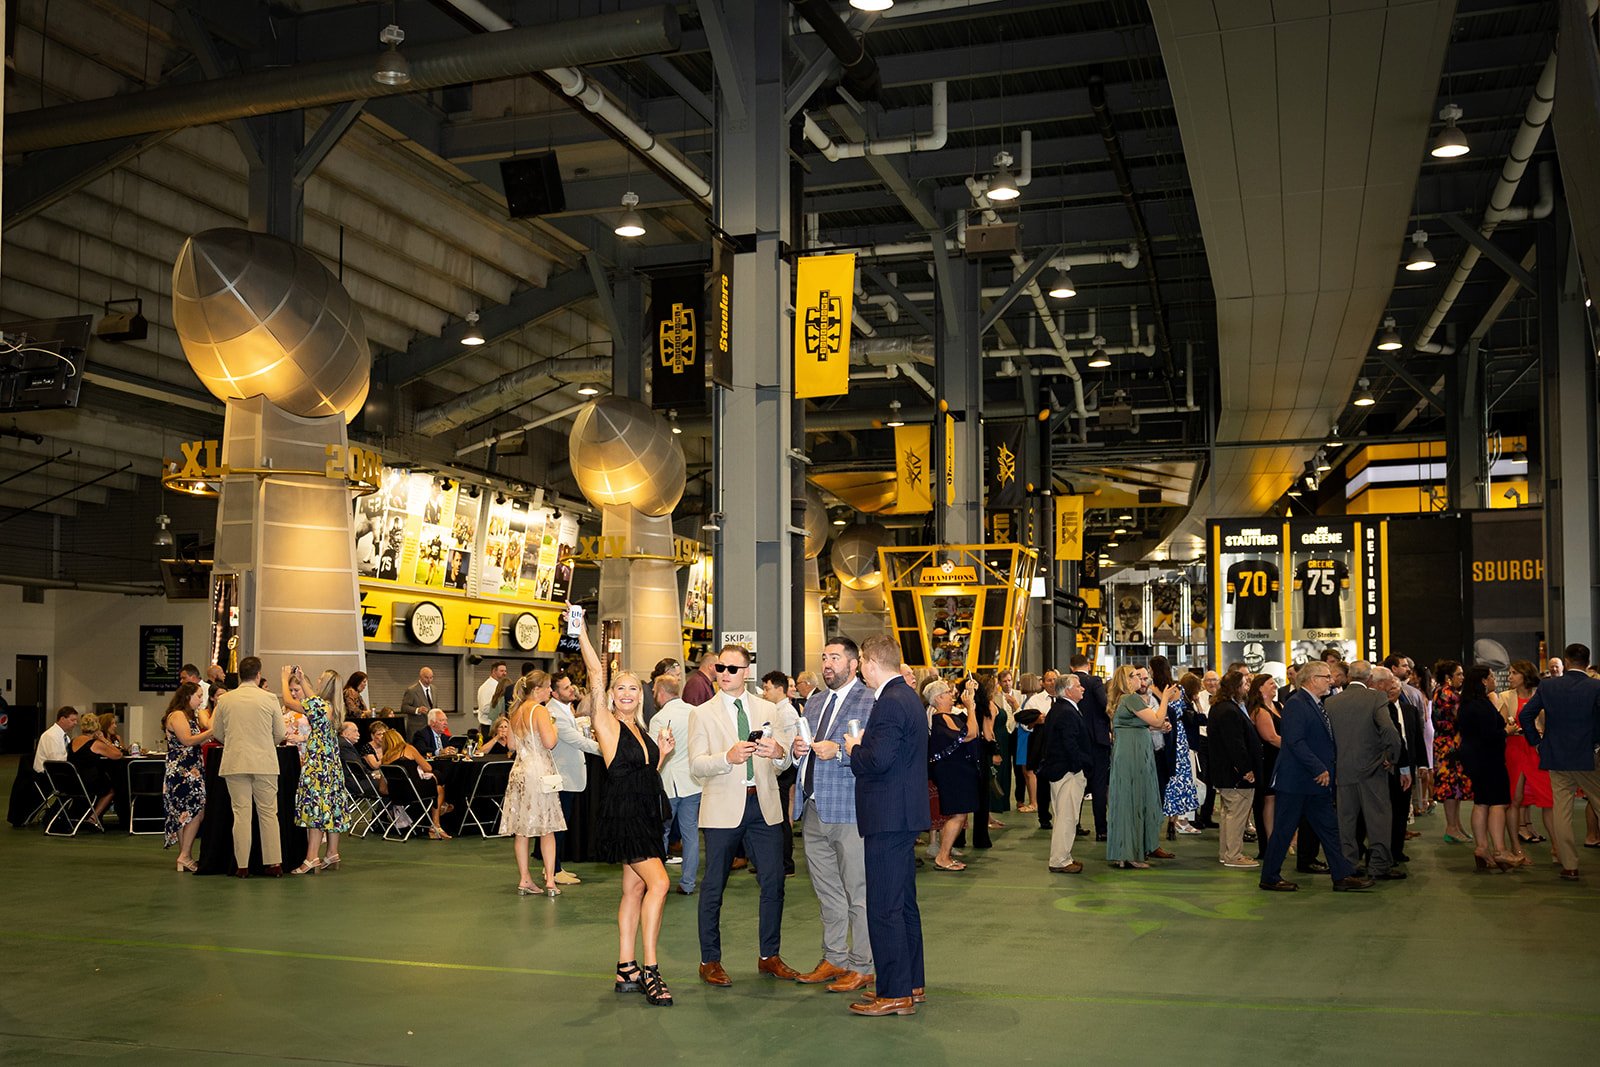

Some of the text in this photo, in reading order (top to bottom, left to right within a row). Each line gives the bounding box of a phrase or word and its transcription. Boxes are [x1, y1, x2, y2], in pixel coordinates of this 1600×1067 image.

[720, 273, 729, 352] Steelers
[180, 440, 229, 478] XL
[580, 535, 627, 560] XIV
[1225, 535, 1278, 546] STAUTNER
[1301, 533, 1342, 544] GREENE
[1308, 560, 1334, 569] GREENE
[1366, 528, 1376, 615] RETIRED
[1239, 571, 1267, 597] 70
[1307, 569, 1335, 595] 75
[725, 634, 744, 642] SKIP
